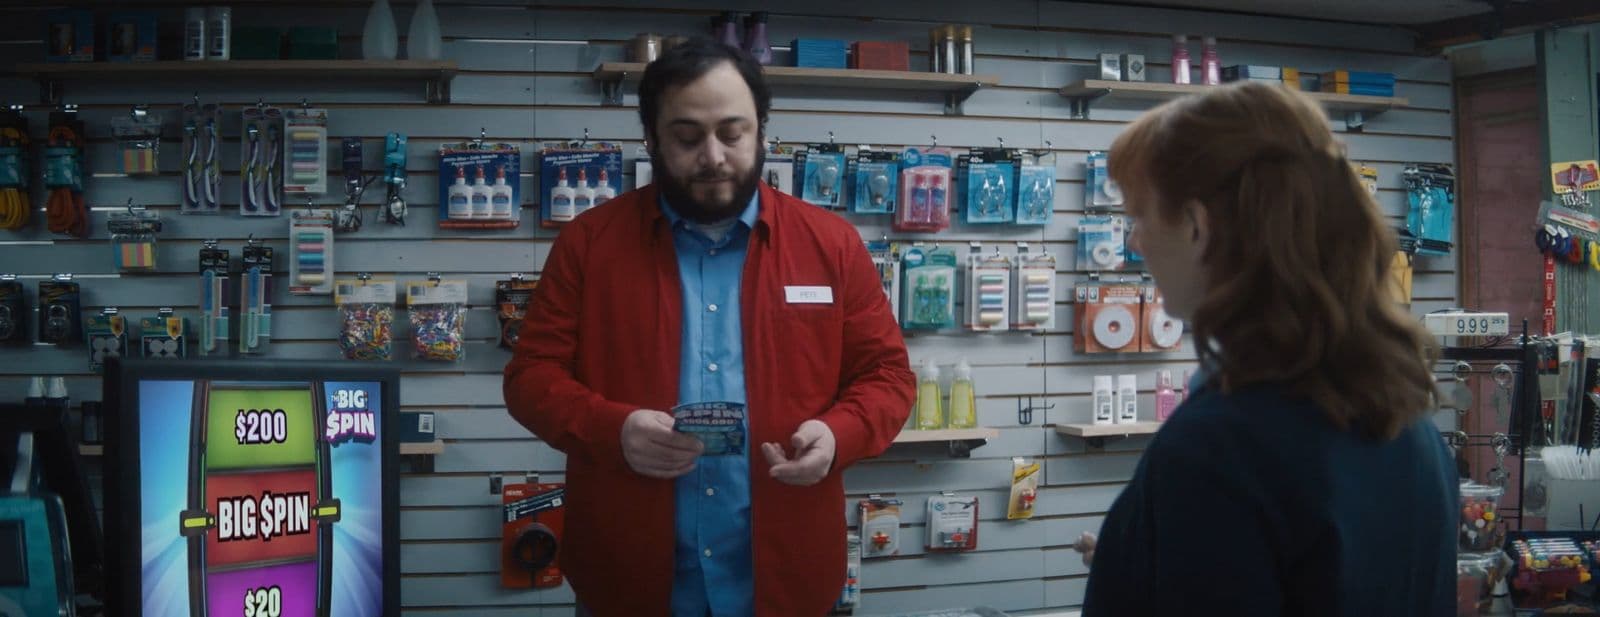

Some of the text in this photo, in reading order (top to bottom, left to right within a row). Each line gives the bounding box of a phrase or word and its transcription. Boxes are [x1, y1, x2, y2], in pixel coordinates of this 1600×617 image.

[1457, 318, 1489, 334] 9.99
[338, 389, 365, 409] BIG
[235, 409, 287, 444] $200
[325, 410, 376, 440] $PIN
[217, 491, 311, 541] BIG $PIN
[244, 586, 282, 617] $20
